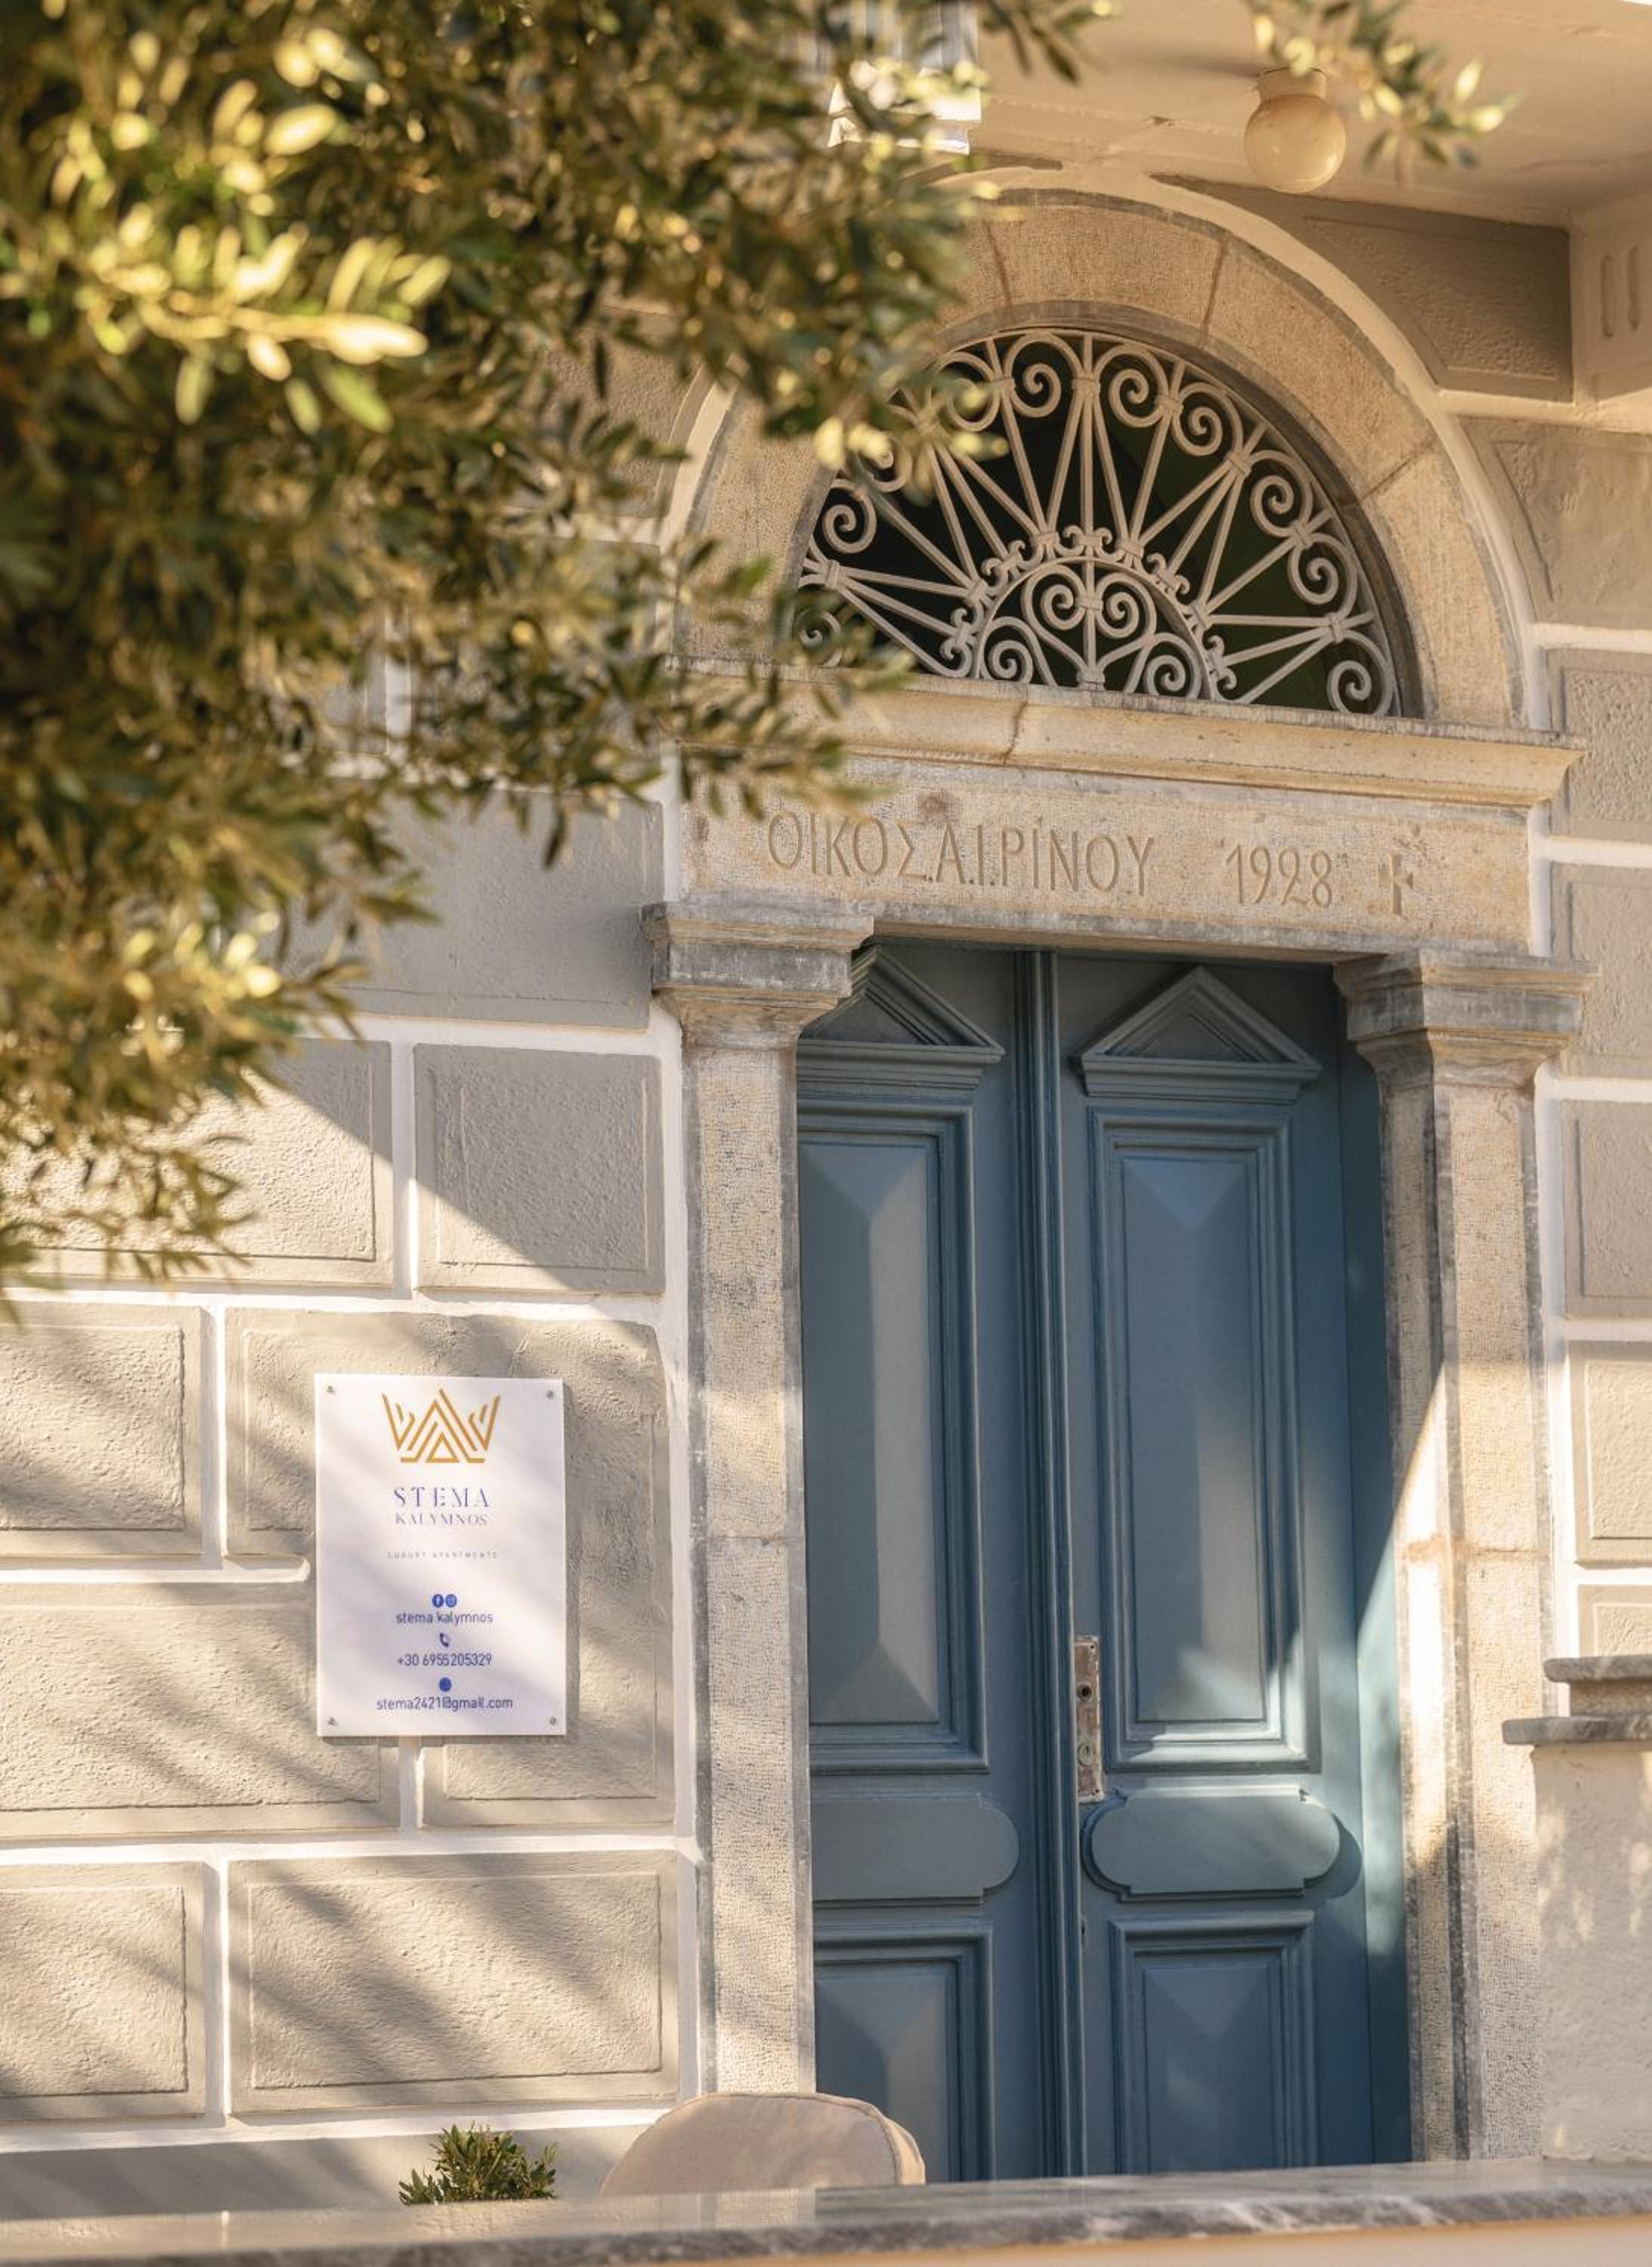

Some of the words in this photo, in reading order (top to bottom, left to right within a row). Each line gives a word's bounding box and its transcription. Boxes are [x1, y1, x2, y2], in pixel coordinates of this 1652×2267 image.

[1226, 845, 1332, 909] 1928
[394, 1486, 490, 1508] STEMA
[395, 1513, 488, 1525] KALYMNOS
[396, 1612, 433, 1623] stema
[437, 1611, 493, 1626] kalymnos
[398, 1653, 419, 1666] +30
